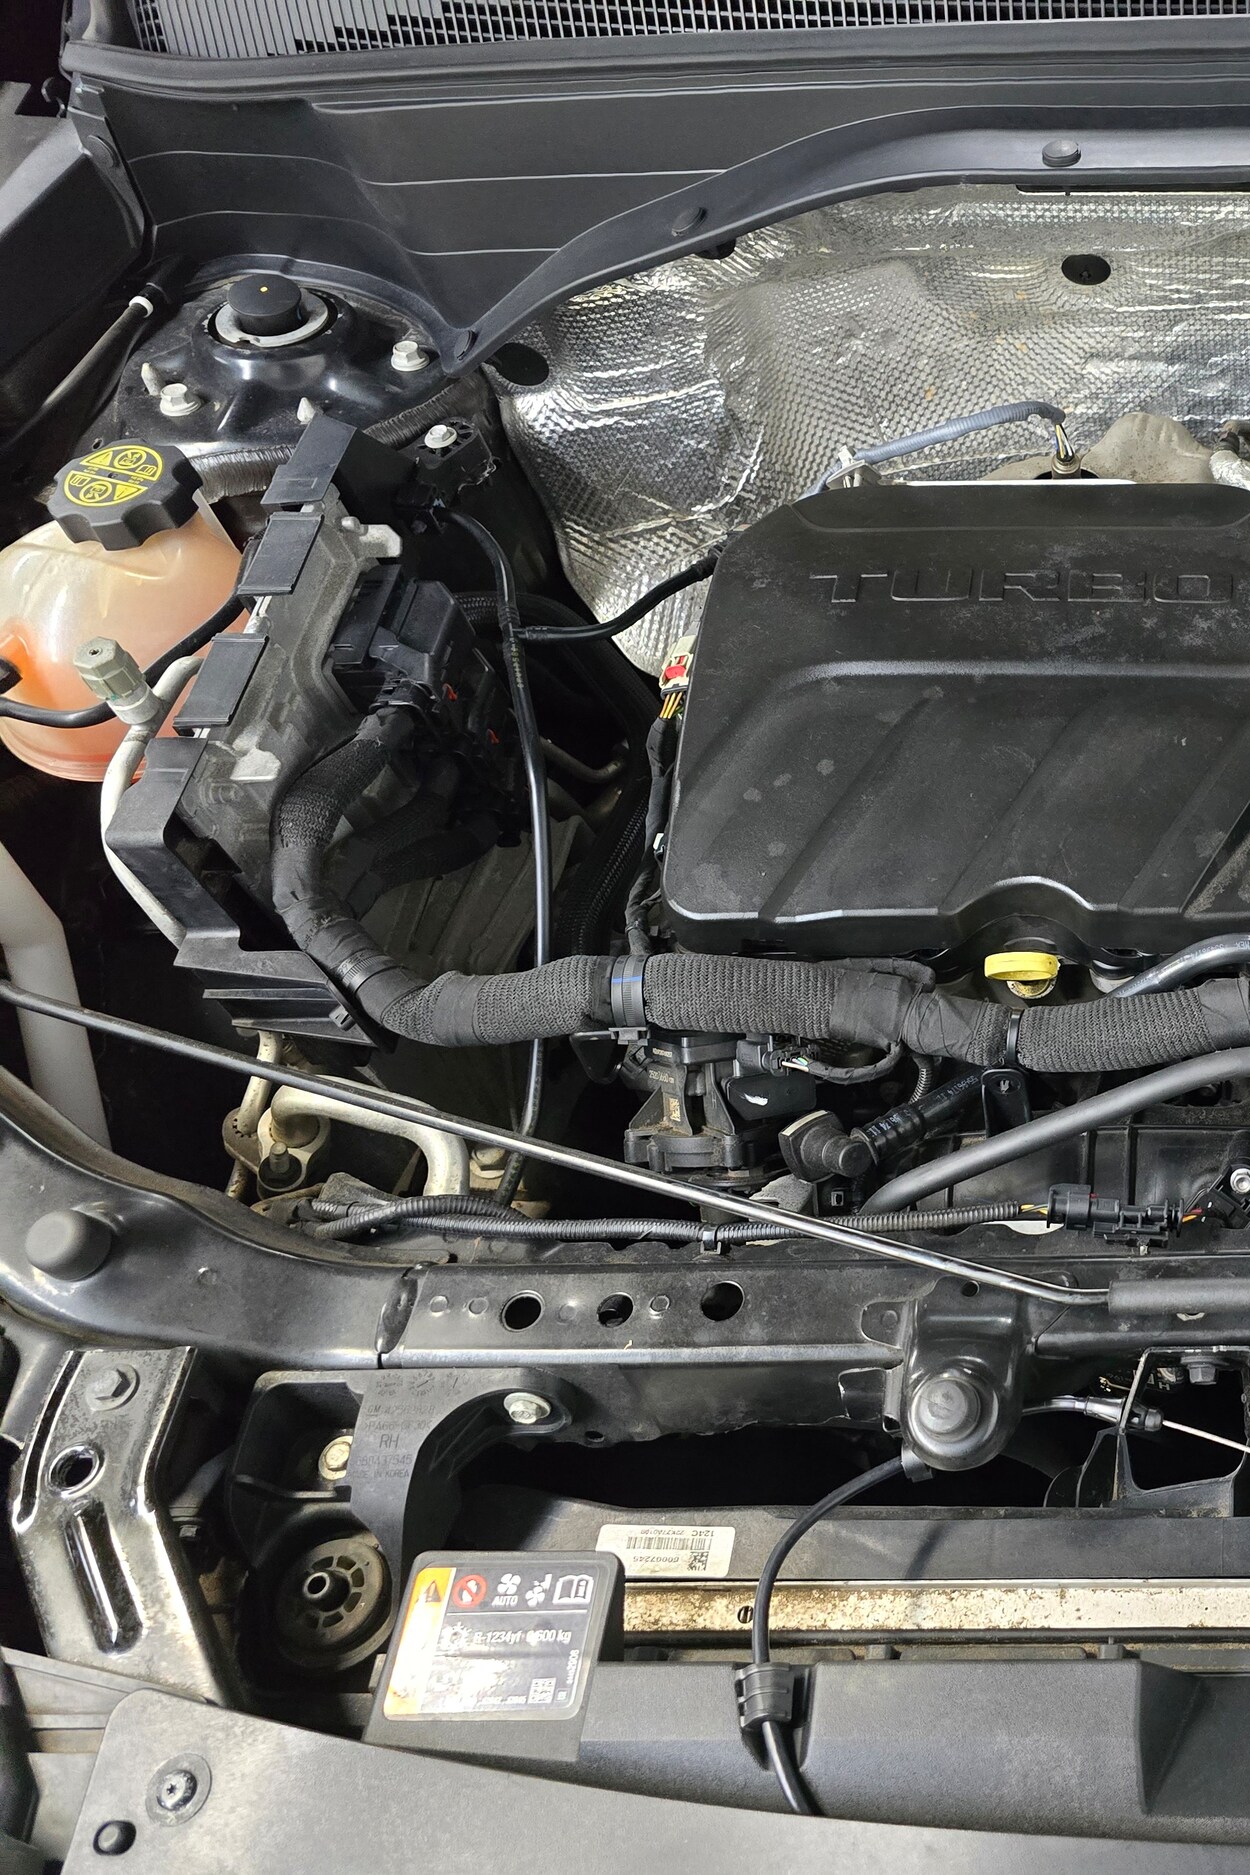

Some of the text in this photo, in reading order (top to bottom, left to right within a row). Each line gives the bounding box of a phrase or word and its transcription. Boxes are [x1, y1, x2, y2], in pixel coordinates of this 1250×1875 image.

[809, 568, 1234, 604] TURBO
[1235, 941, 1250, 950] MEX
[380, 1434, 399, 1449] RH
[691, 1529, 715, 1537] 124C
[492, 1596, 518, 1607] AUTO
[556, 1630, 572, 1645] kg
